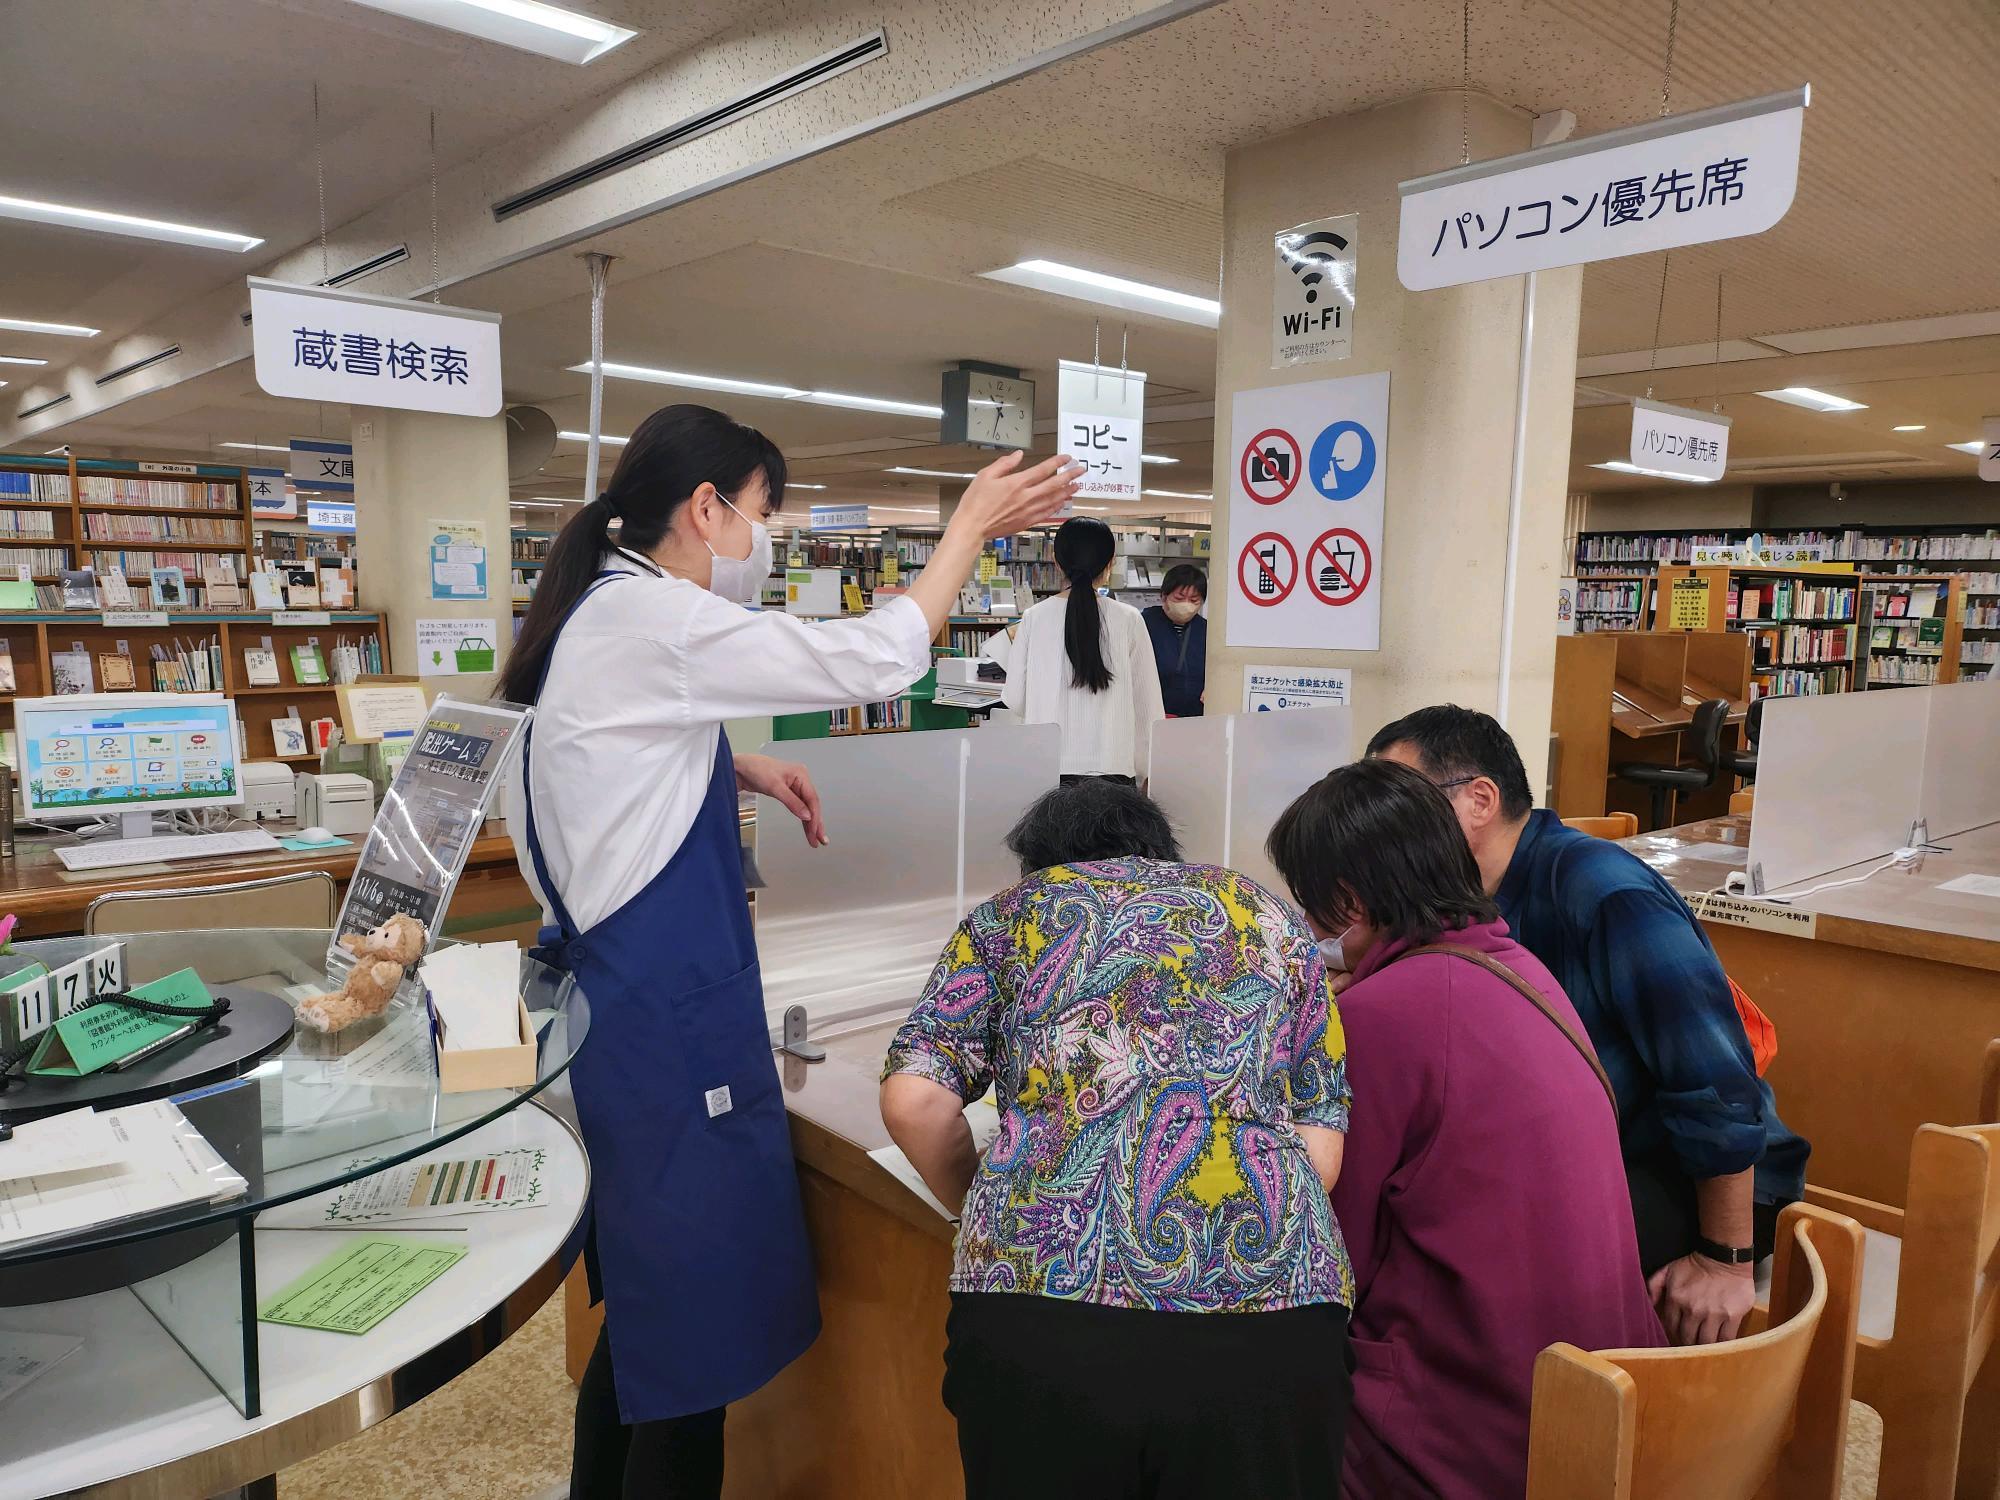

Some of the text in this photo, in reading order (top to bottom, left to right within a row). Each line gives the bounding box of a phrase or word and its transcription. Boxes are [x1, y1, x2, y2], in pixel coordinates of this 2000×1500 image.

[1432, 157, 1749, 257] パソコン優先席
[1283, 306, 1341, 336] Wi-Fi
[293, 327, 469, 386] 蔵書検索
[1074, 424, 1127, 450] コピー
[1642, 429, 1718, 463] パソコン優先席
[419, 731, 472, 761] 脱出ゲーム
[358, 877, 380, 900] 11/6
[64, 973, 78, 1007] 7
[99, 959, 117, 993] 火
[21, 990, 41, 1029] 11
